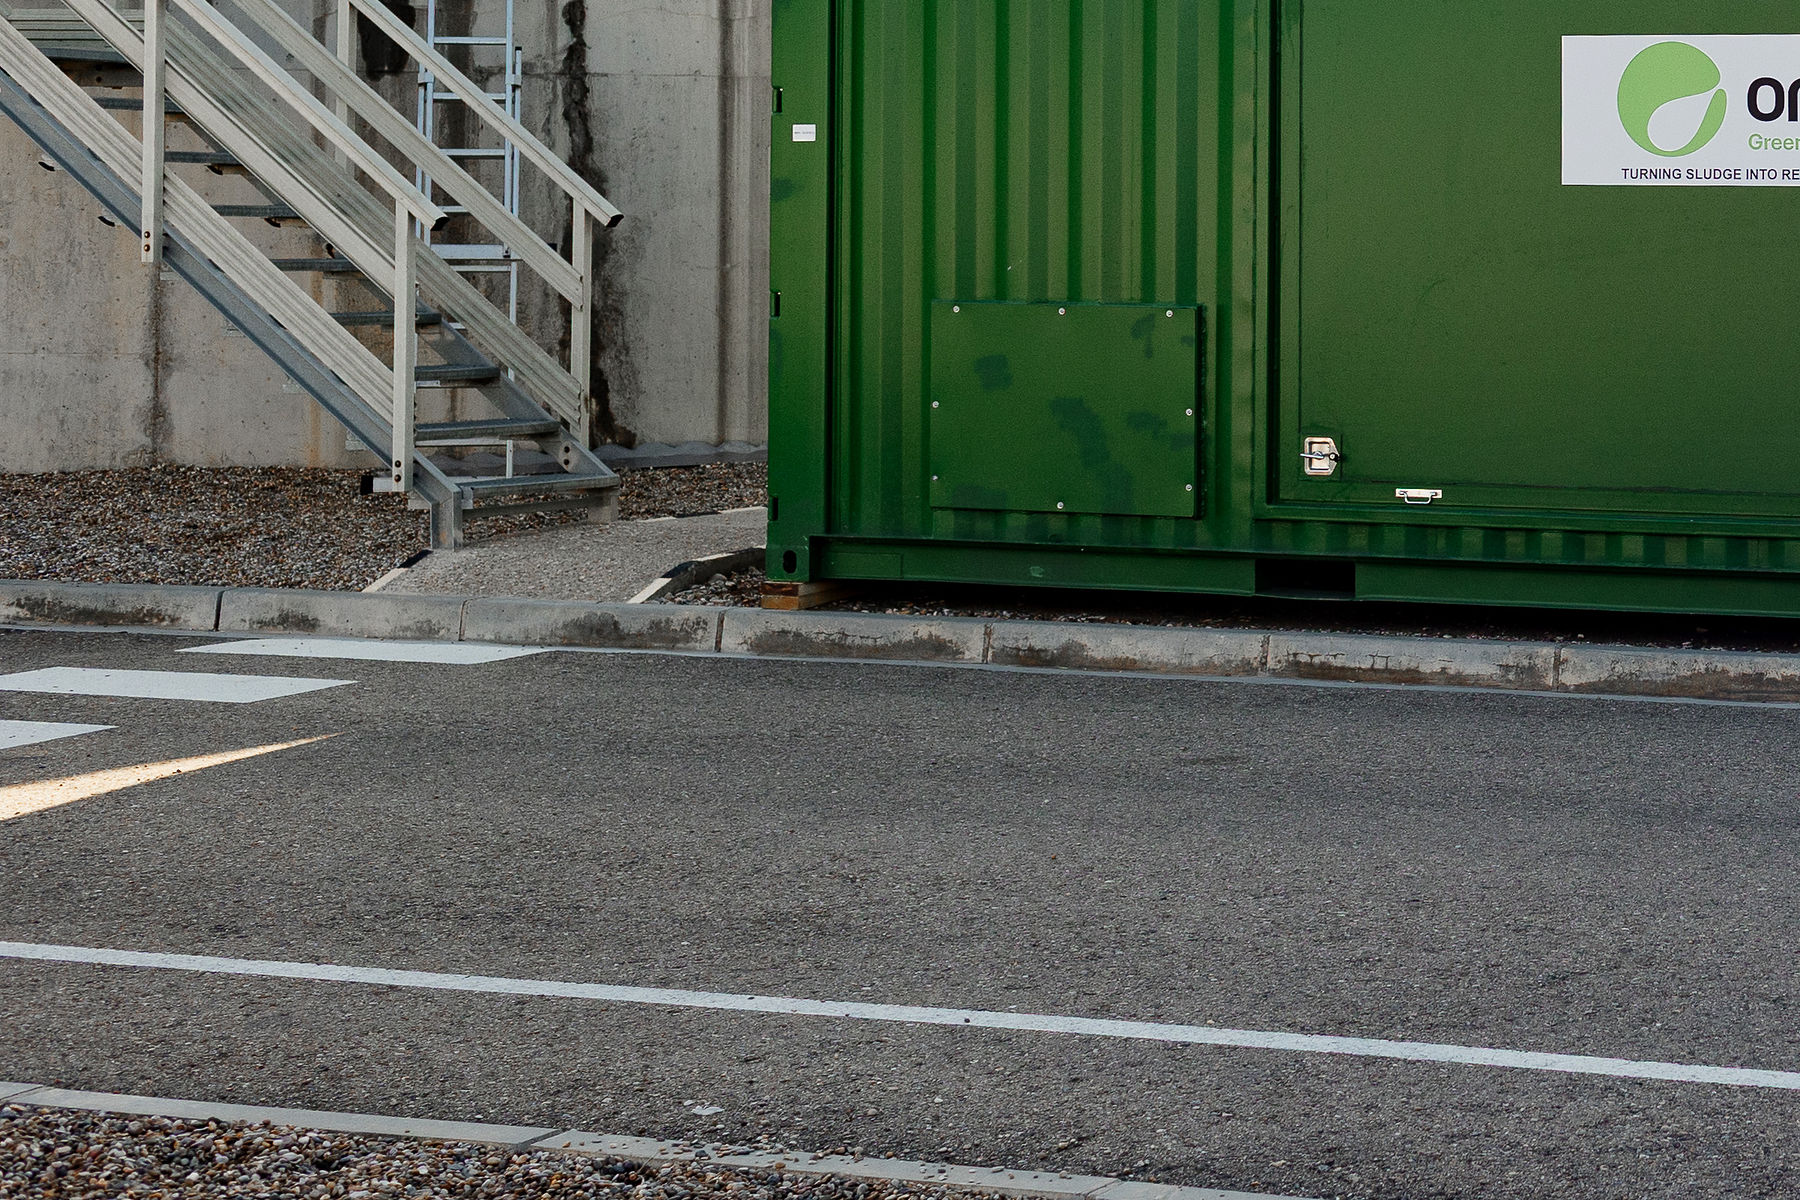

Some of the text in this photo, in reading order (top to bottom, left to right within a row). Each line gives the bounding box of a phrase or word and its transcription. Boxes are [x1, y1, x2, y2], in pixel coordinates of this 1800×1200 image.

[1621, 168, 1682, 180] TURNING
[1686, 168, 1742, 180] SLUDGE
[1746, 168, 1778, 180] INTO
